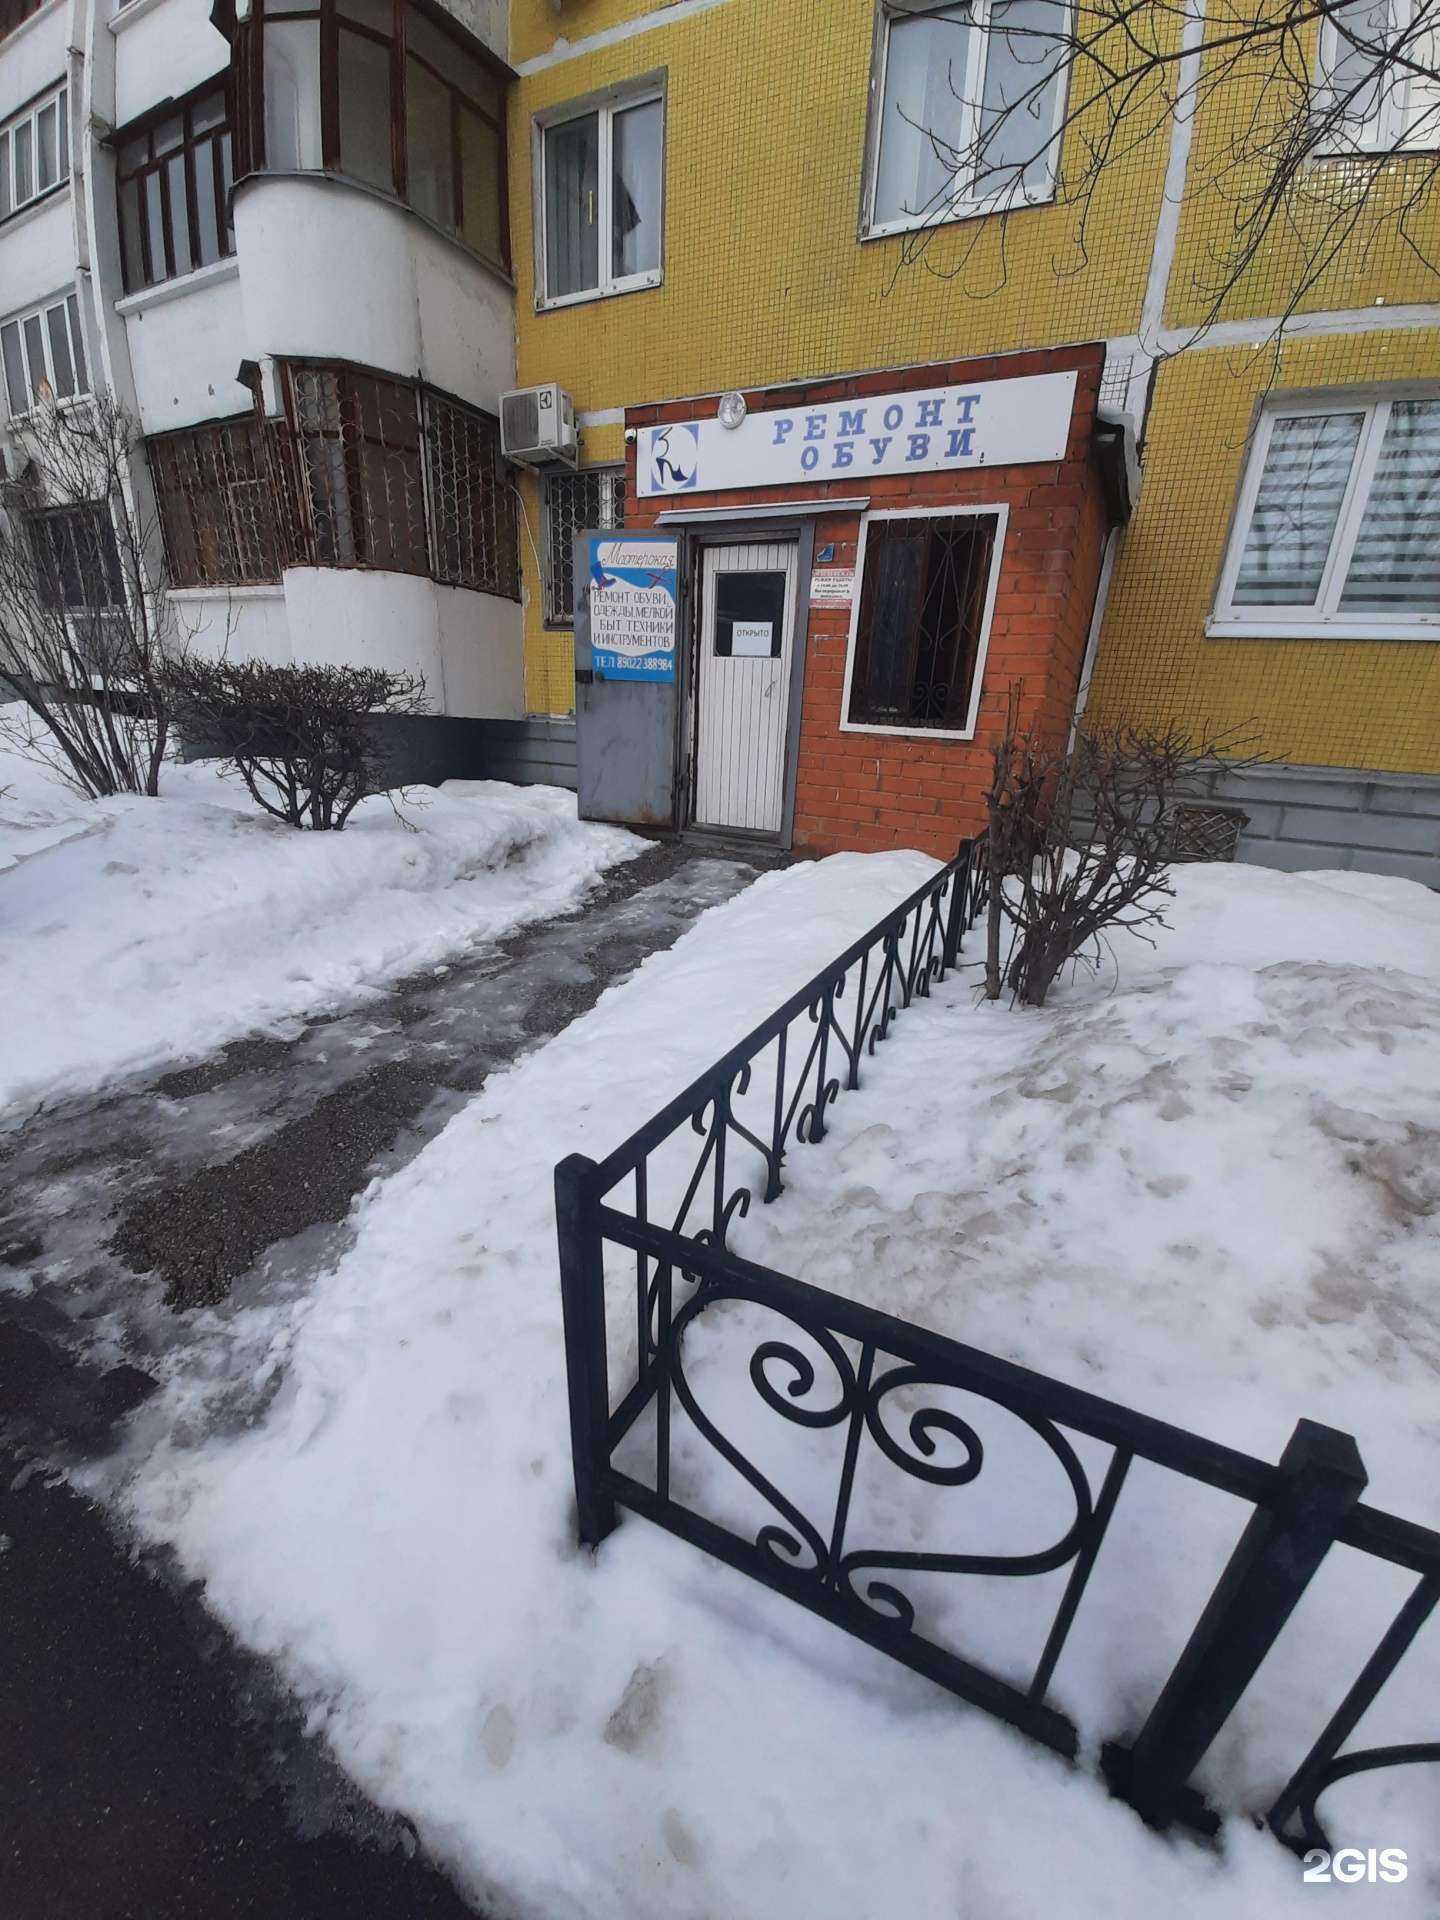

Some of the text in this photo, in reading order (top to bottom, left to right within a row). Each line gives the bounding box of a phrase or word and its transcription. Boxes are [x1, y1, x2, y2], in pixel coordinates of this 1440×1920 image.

[772, 394, 981, 445] РЕМОНТ
[800, 427, 976, 471] ОБУВИ
[593, 591, 630, 603] РЕМОНТ
[600, 619, 674, 633] БЫТ ТЕХНИКИ
[736, 629, 769, 638] ОТКРЫТО
